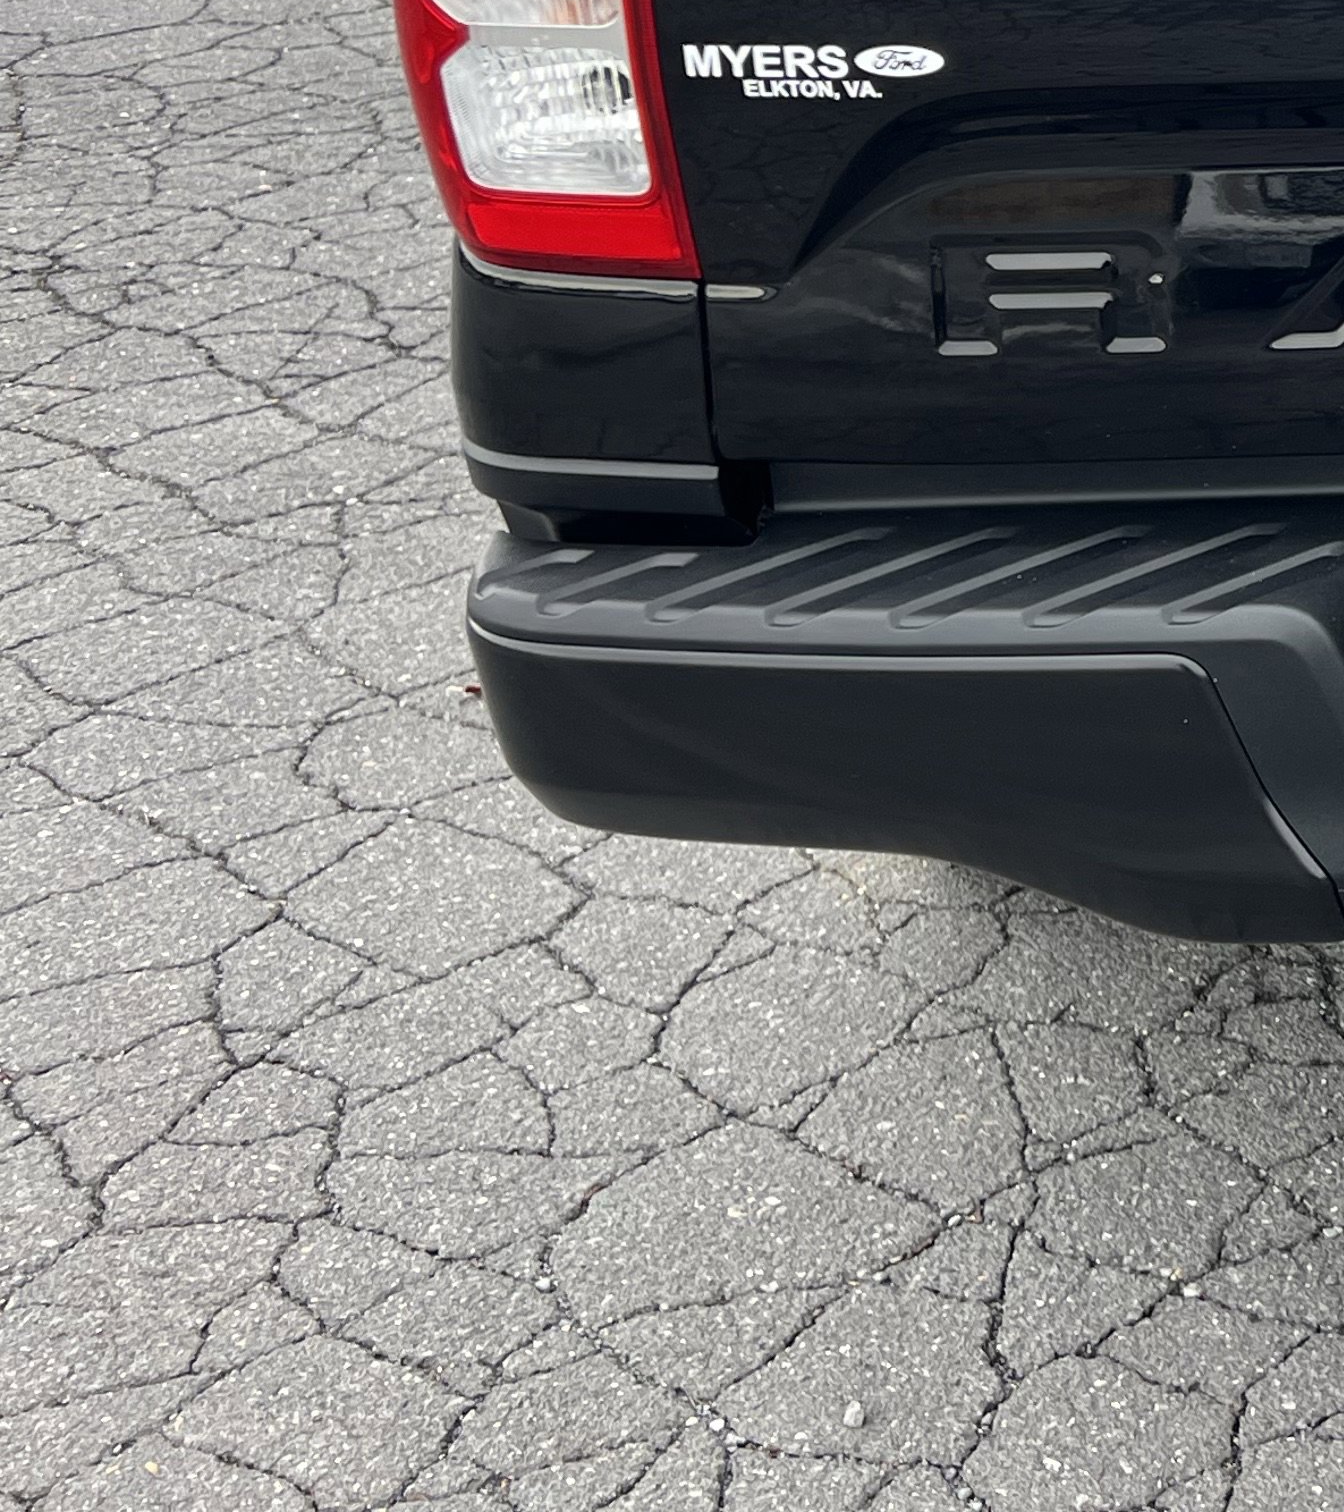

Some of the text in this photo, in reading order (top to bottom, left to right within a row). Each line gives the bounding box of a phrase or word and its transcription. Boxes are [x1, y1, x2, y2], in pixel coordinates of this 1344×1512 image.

[682, 43, 850, 79] MYERS
[742, 79, 883, 101] ELKTON, VA.
